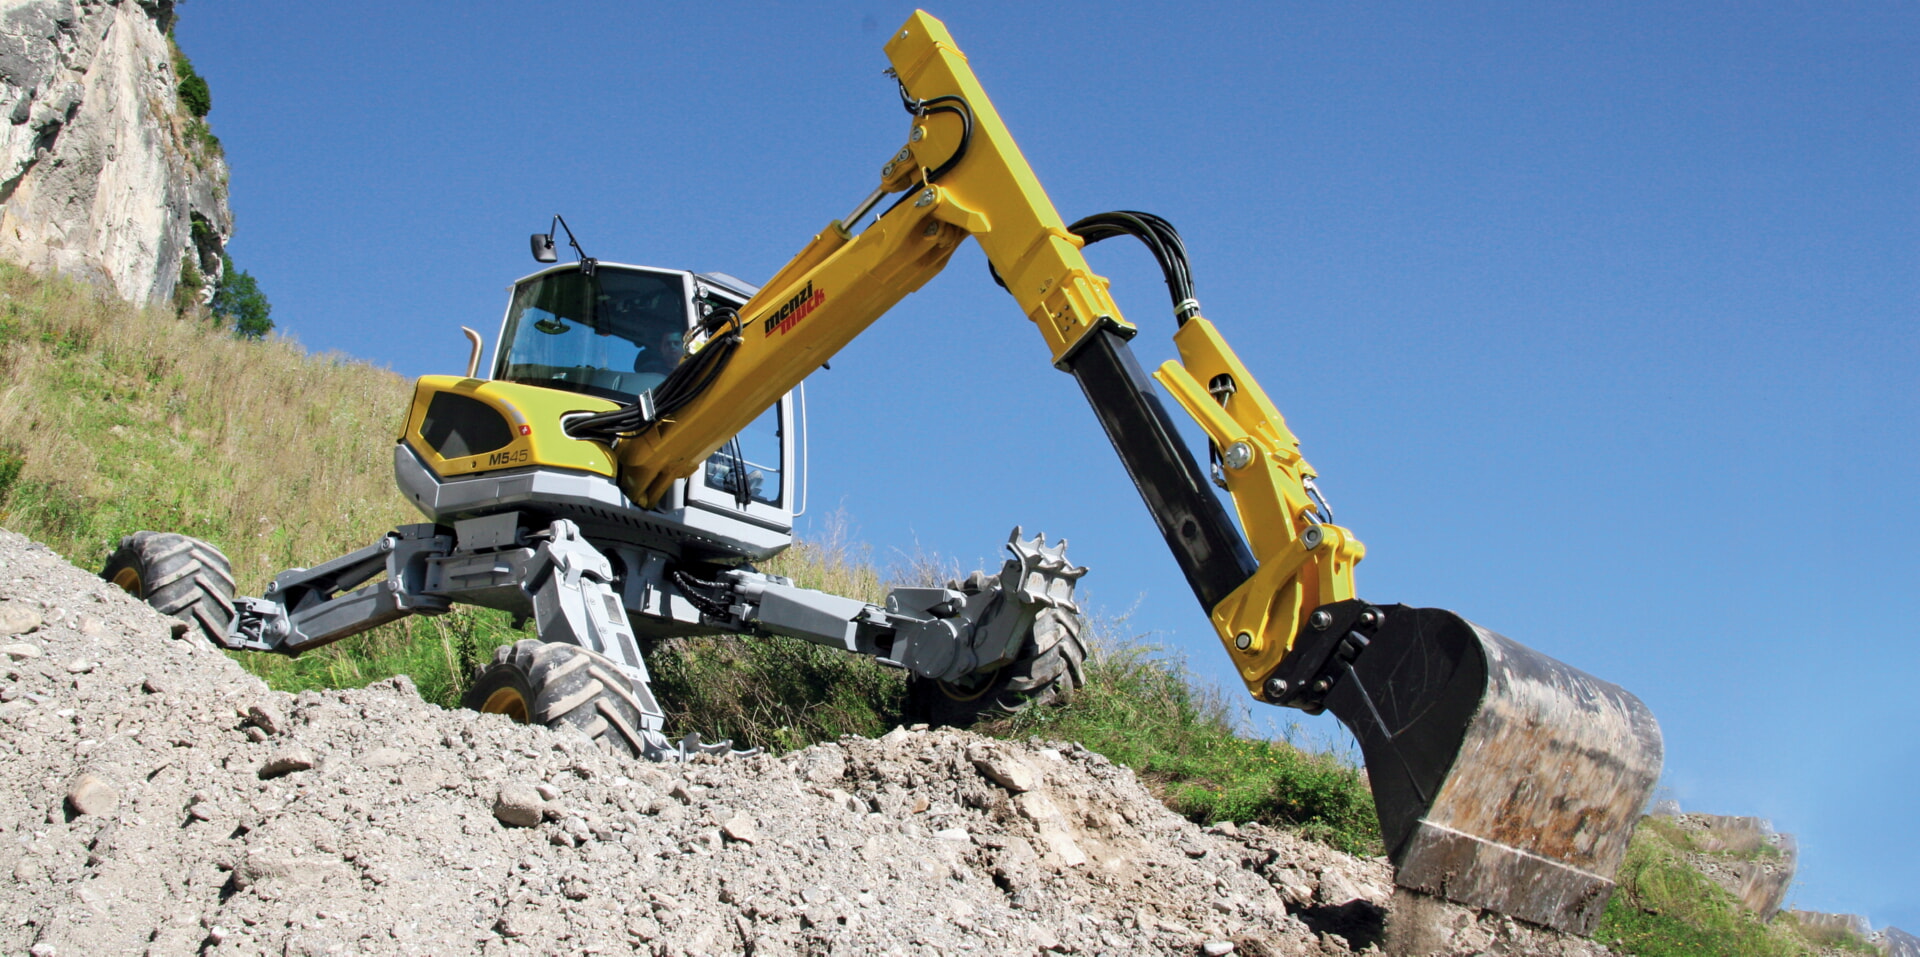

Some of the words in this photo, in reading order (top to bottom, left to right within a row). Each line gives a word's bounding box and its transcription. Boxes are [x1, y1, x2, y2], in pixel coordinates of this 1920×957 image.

[764, 280, 813, 334] menzi
[778, 288, 826, 336] muck
[489, 449, 528, 466] M545
